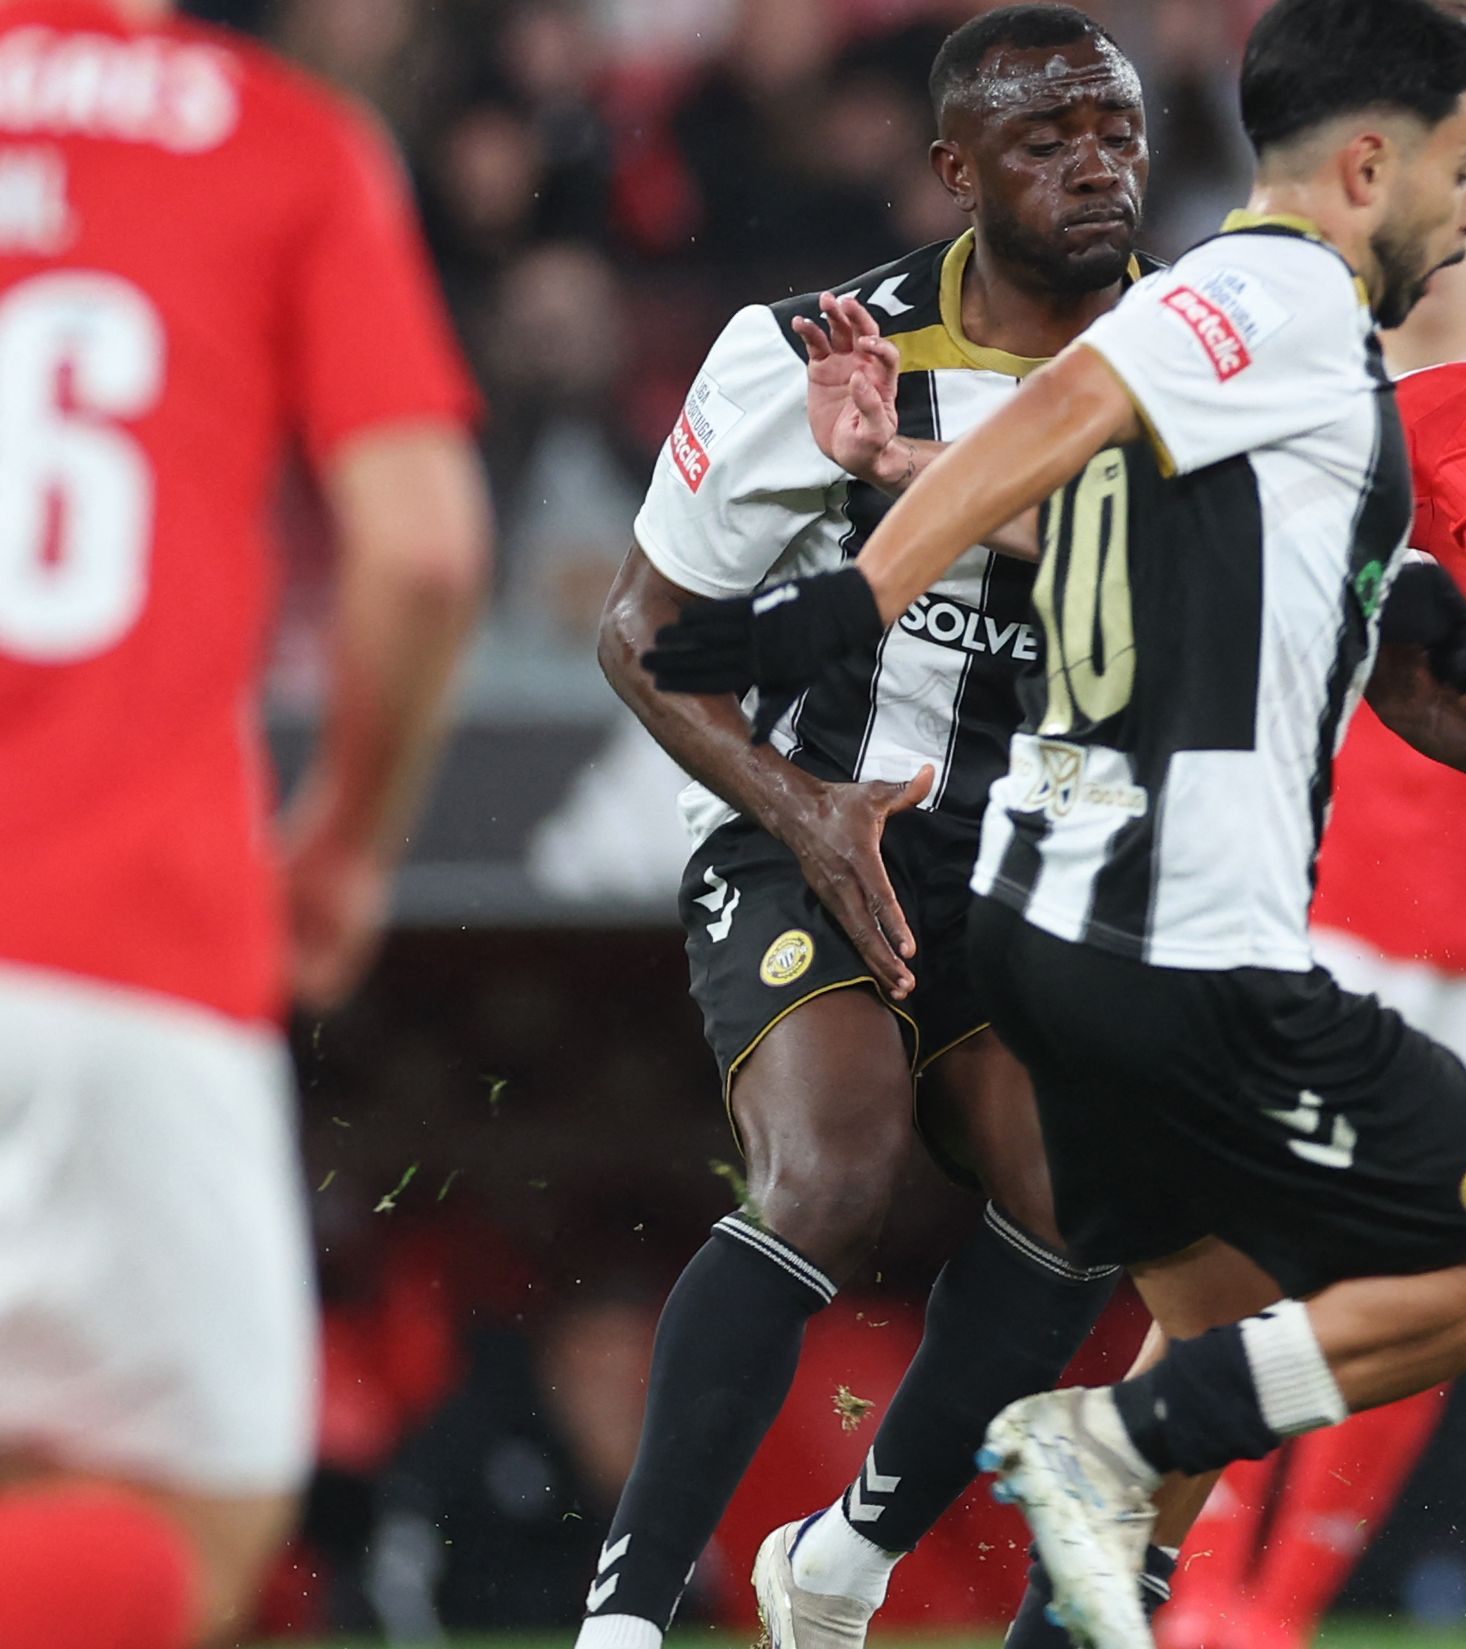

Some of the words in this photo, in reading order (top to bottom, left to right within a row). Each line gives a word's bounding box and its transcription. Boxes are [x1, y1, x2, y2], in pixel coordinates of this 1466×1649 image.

[687, 394, 717, 449] PORTUGAL
[694, 379, 711, 405] LIGA
[0, 268, 167, 664] 6
[672, 414, 703, 482] etclic
